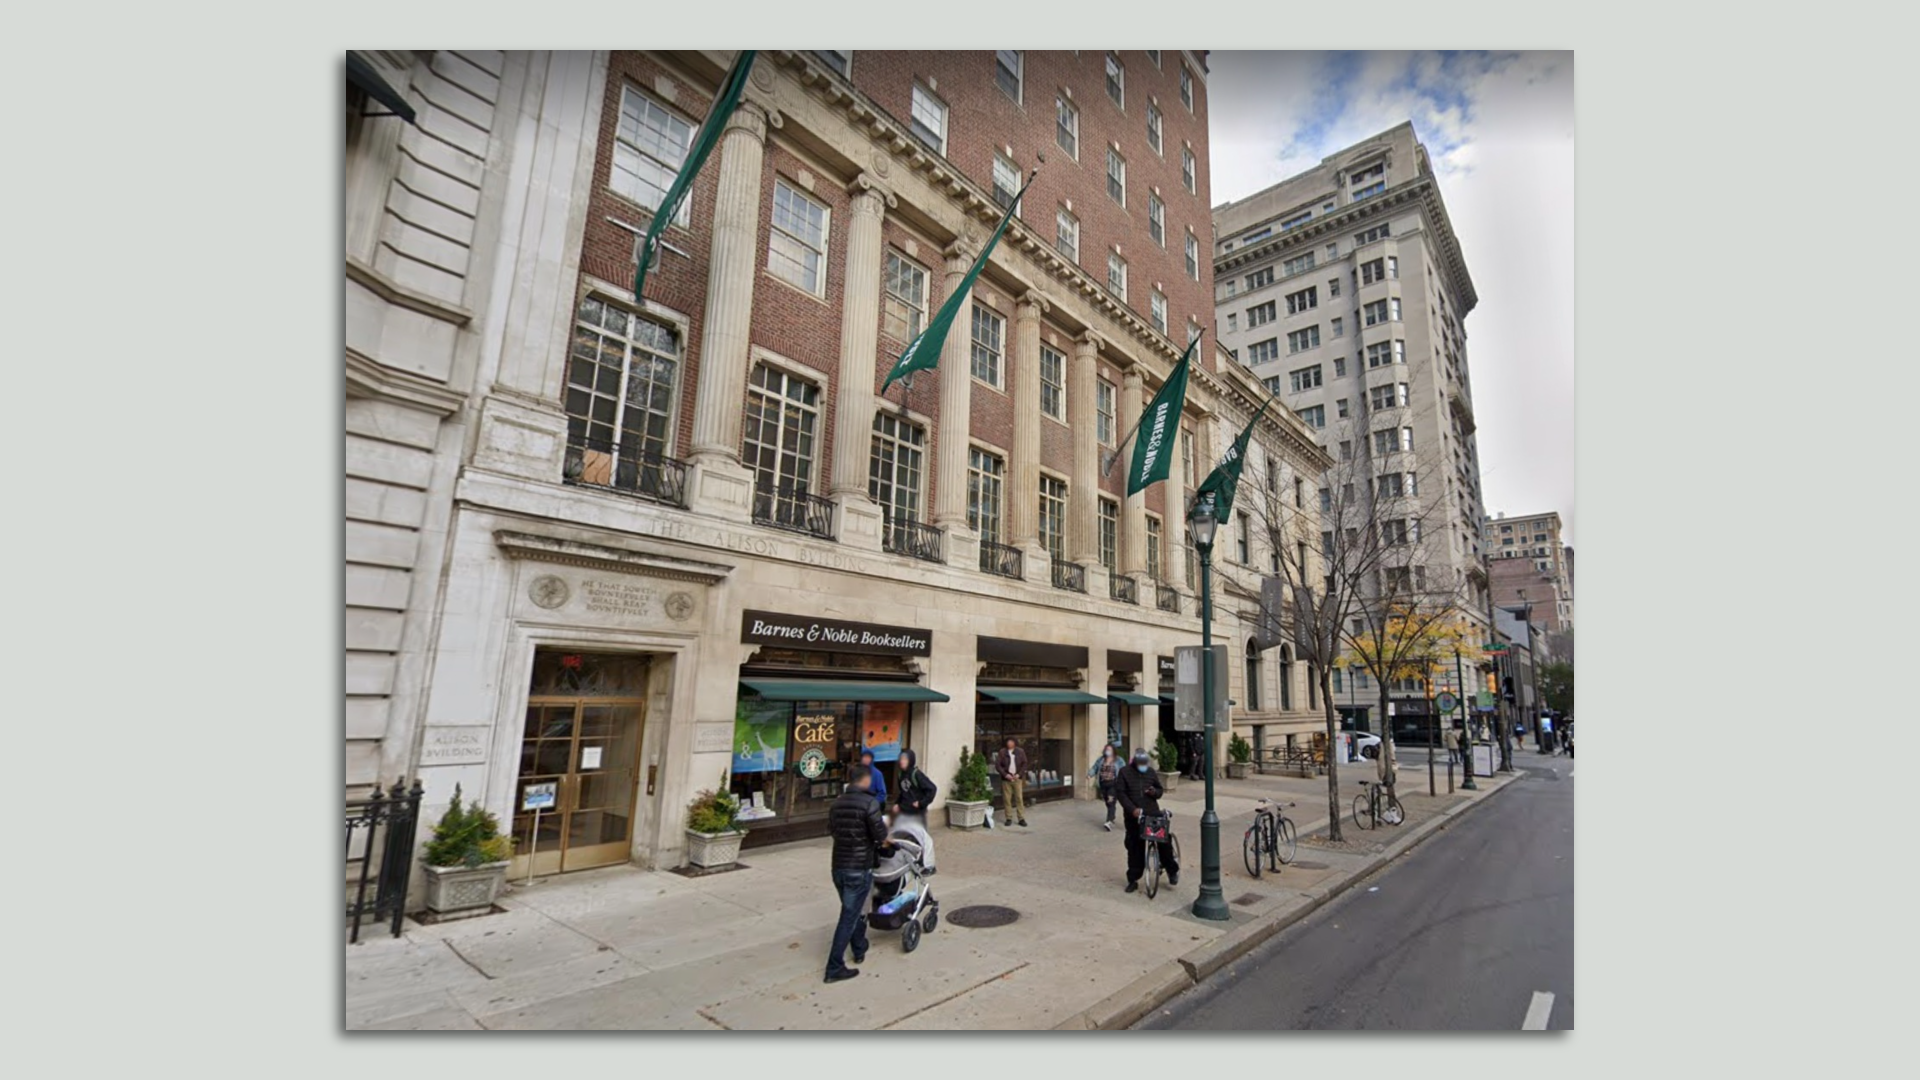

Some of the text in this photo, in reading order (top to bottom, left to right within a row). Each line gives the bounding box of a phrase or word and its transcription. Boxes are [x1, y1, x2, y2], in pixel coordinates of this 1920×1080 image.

[650, 520, 684, 539] THE
[714, 532, 779, 557] ALISON
[581, 580, 594, 588] HE
[598, 581, 621, 590] THAT
[591, 597, 646, 608] SHALL REAP
[751, 619, 926, 650] Barnes & Noble Booksellers
[434, 735, 478, 745] ALISON
[794, 722, 835, 743] Café
[740, 745, 752, 760] &
